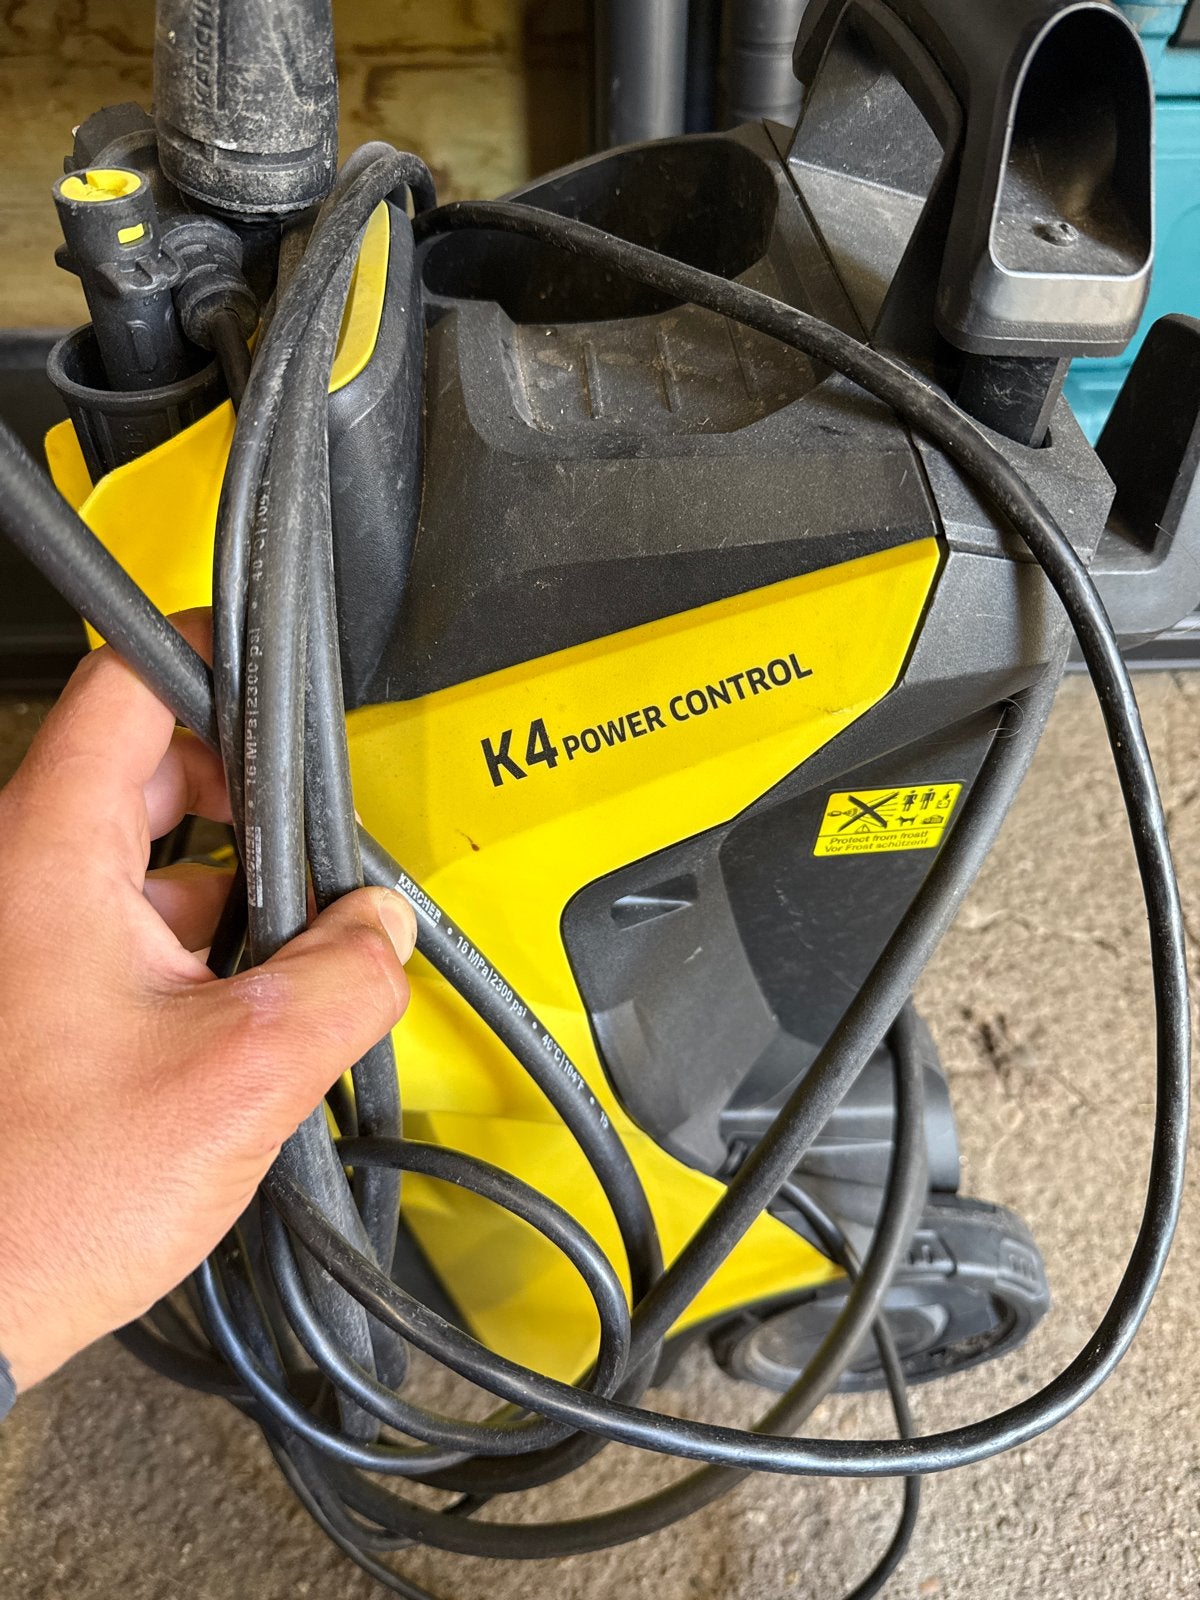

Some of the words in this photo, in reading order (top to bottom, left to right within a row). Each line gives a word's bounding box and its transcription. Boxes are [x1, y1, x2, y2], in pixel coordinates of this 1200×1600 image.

[480, 717, 559, 787] K4
[562, 704, 667, 761] POWER
[669, 652, 814, 722] CONTROL
[825, 844, 843, 853] Vor
[845, 842, 873, 851] Frost
[875, 838, 928, 849] schützen!
[829, 836, 870, 845] Protect
[873, 833, 897, 842] from
[900, 830, 929, 839] frost!
[456, 935, 469, 954] 16
[509, 999, 528, 1018] psi
